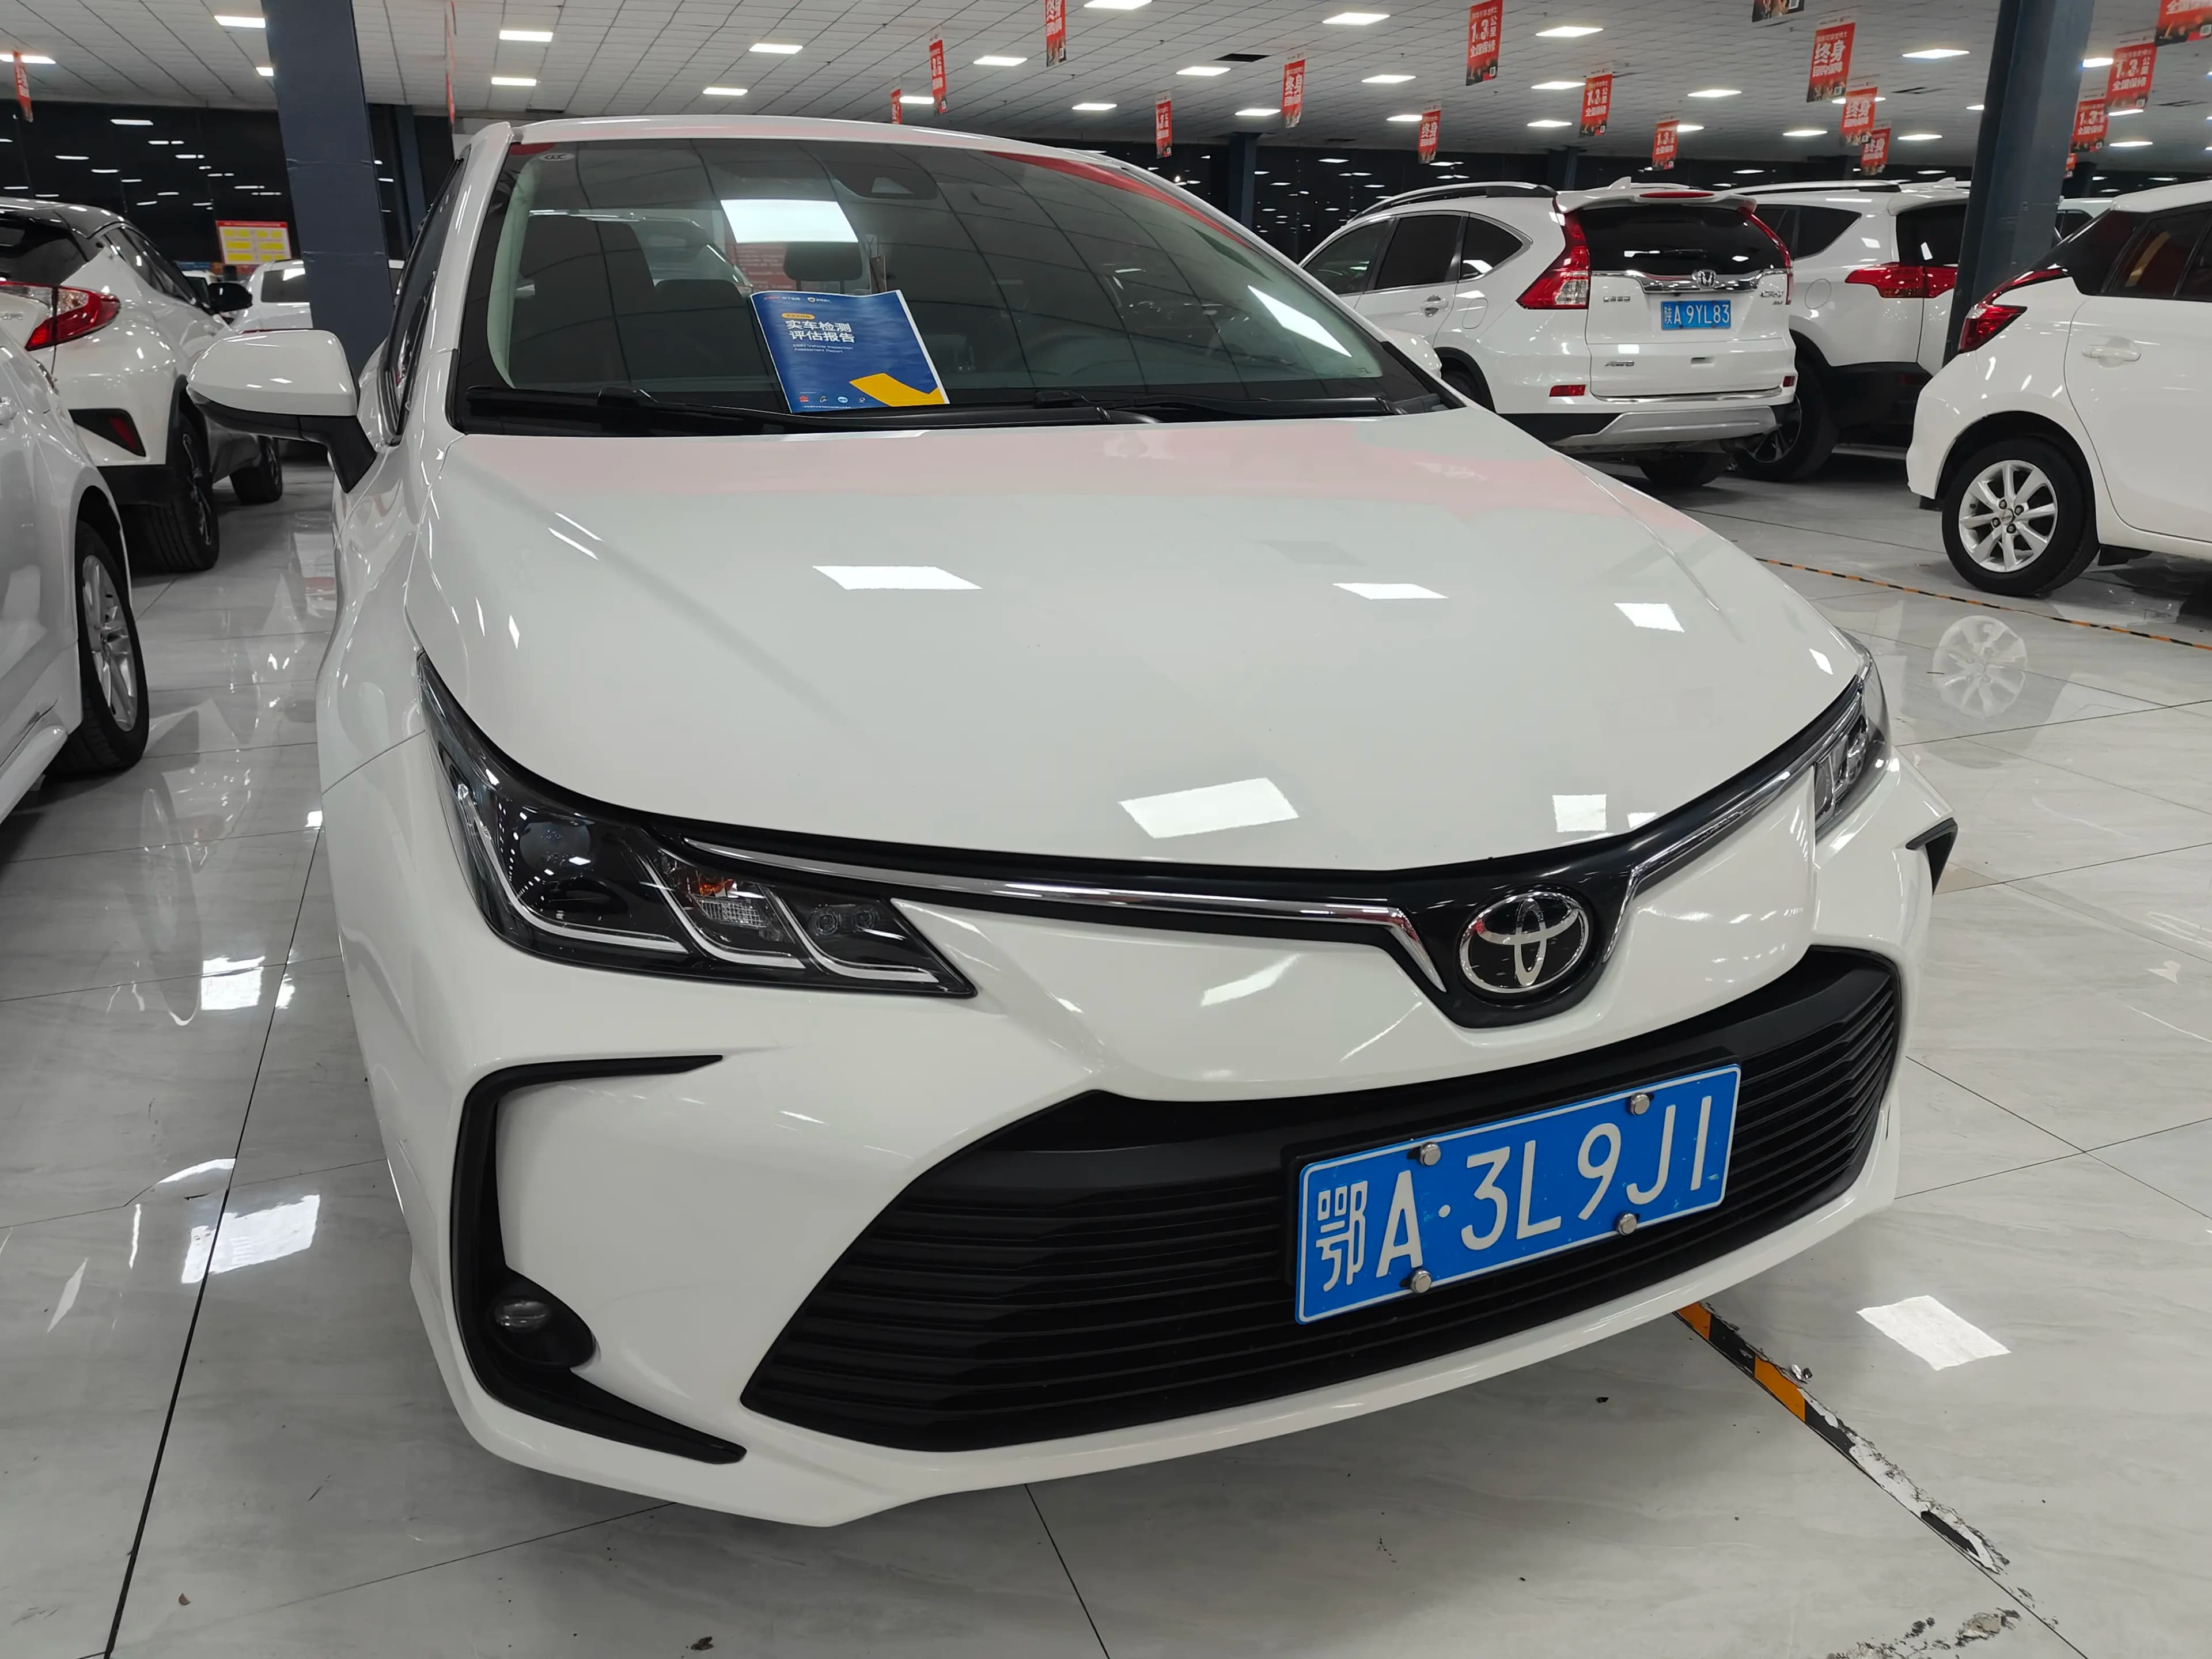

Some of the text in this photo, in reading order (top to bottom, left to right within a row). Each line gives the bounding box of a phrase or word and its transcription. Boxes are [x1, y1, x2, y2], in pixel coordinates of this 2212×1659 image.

[1813, 39, 1846, 65] 终身
[785, 320, 852, 332] 实车检测
[789, 330, 855, 343] 评估报告
